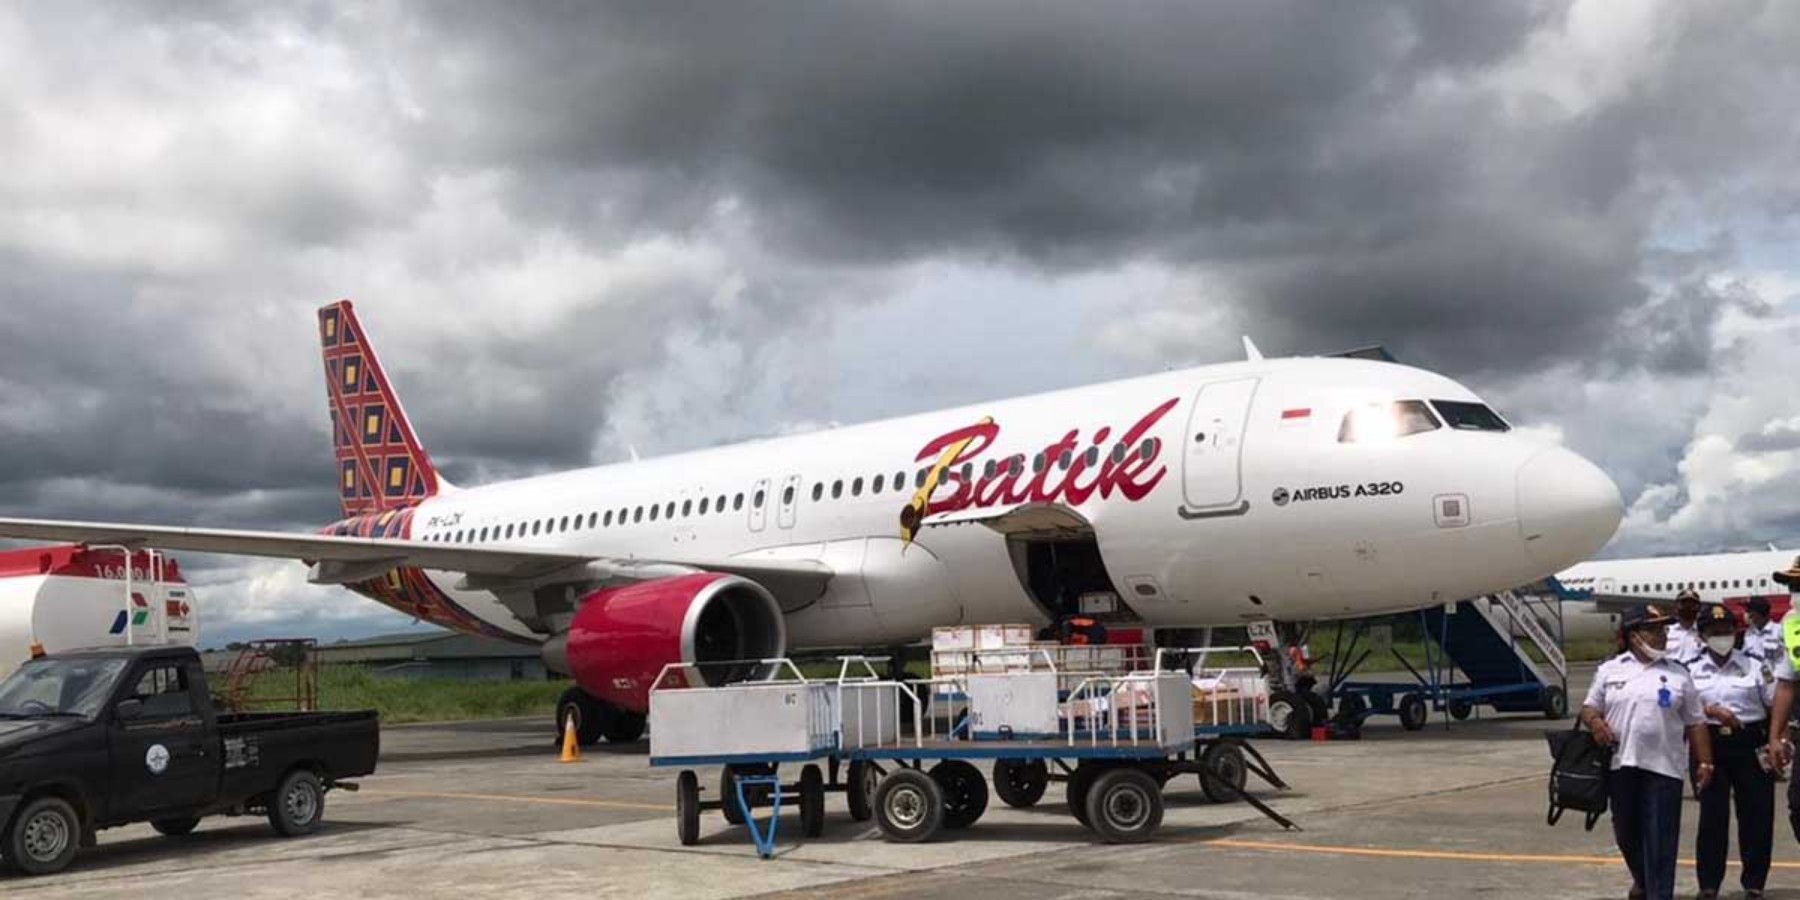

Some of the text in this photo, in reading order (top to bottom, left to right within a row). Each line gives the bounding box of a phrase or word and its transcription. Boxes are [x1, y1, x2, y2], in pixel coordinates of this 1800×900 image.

[913, 397, 1179, 515] Batik
[1291, 481, 1403, 502] AIRBUS A320
[1250, 624, 1273, 637] LZK
